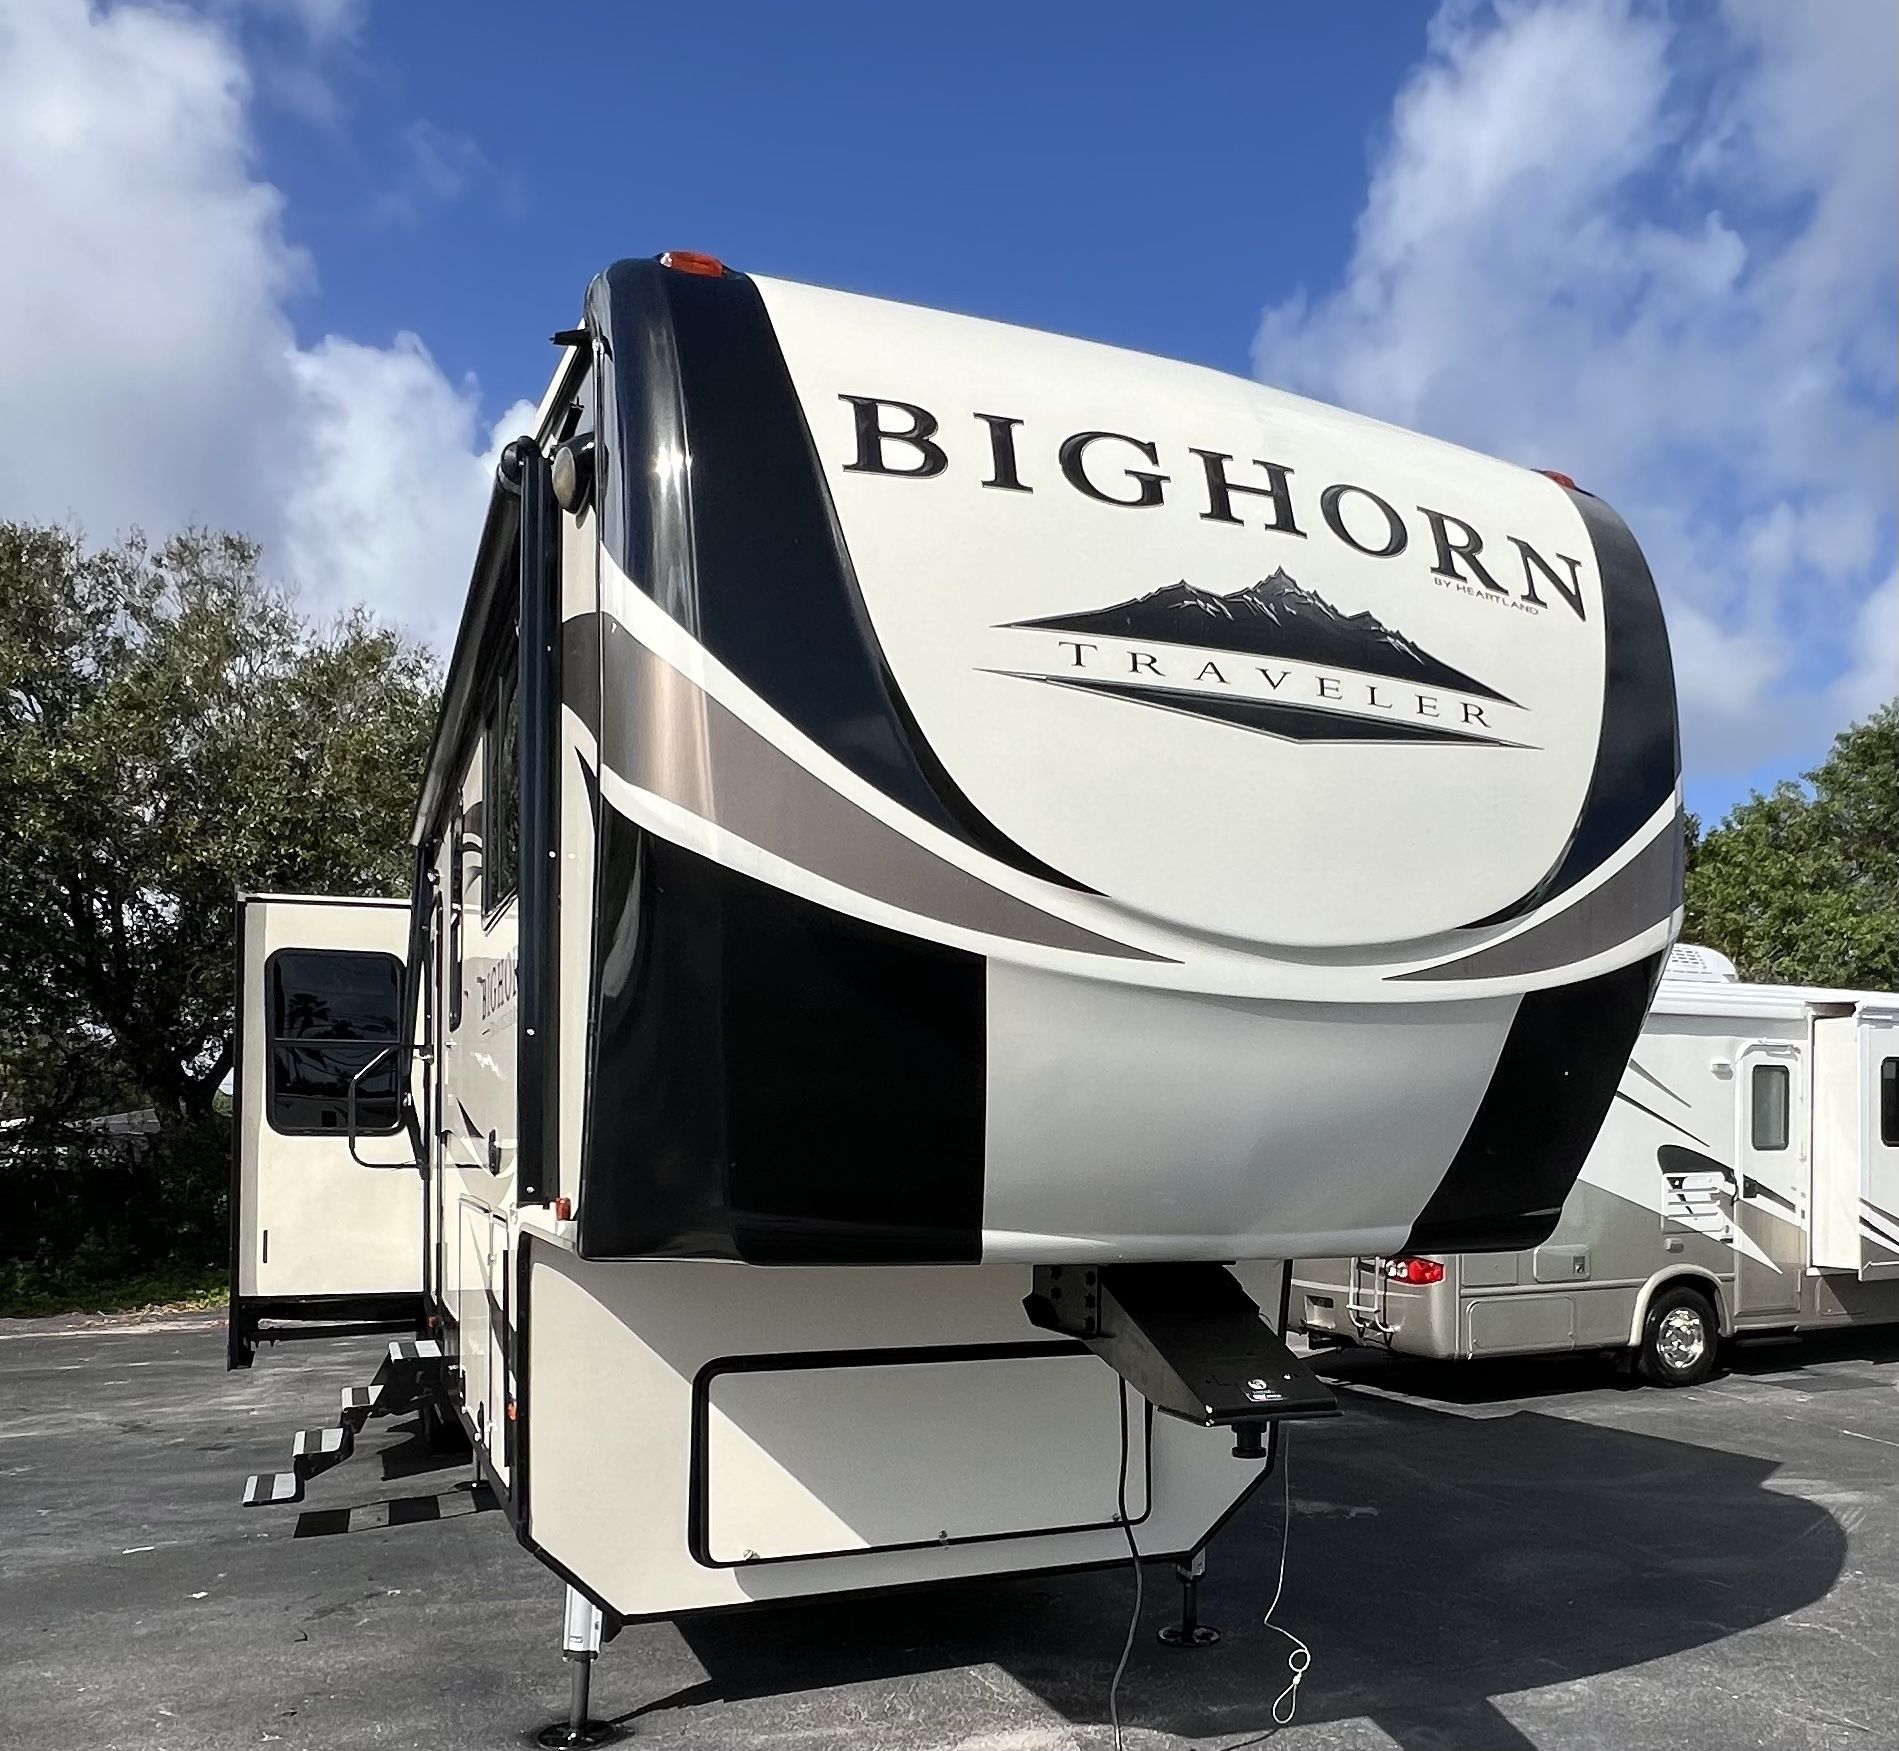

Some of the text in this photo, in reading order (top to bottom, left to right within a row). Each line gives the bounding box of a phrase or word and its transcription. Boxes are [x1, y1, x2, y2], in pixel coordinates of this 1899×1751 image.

[837, 393, 1587, 622] BIGHORN
[1434, 577, 1539, 616] BY HEARTLAND
[1058, 640, 1493, 728] TRAVELER
